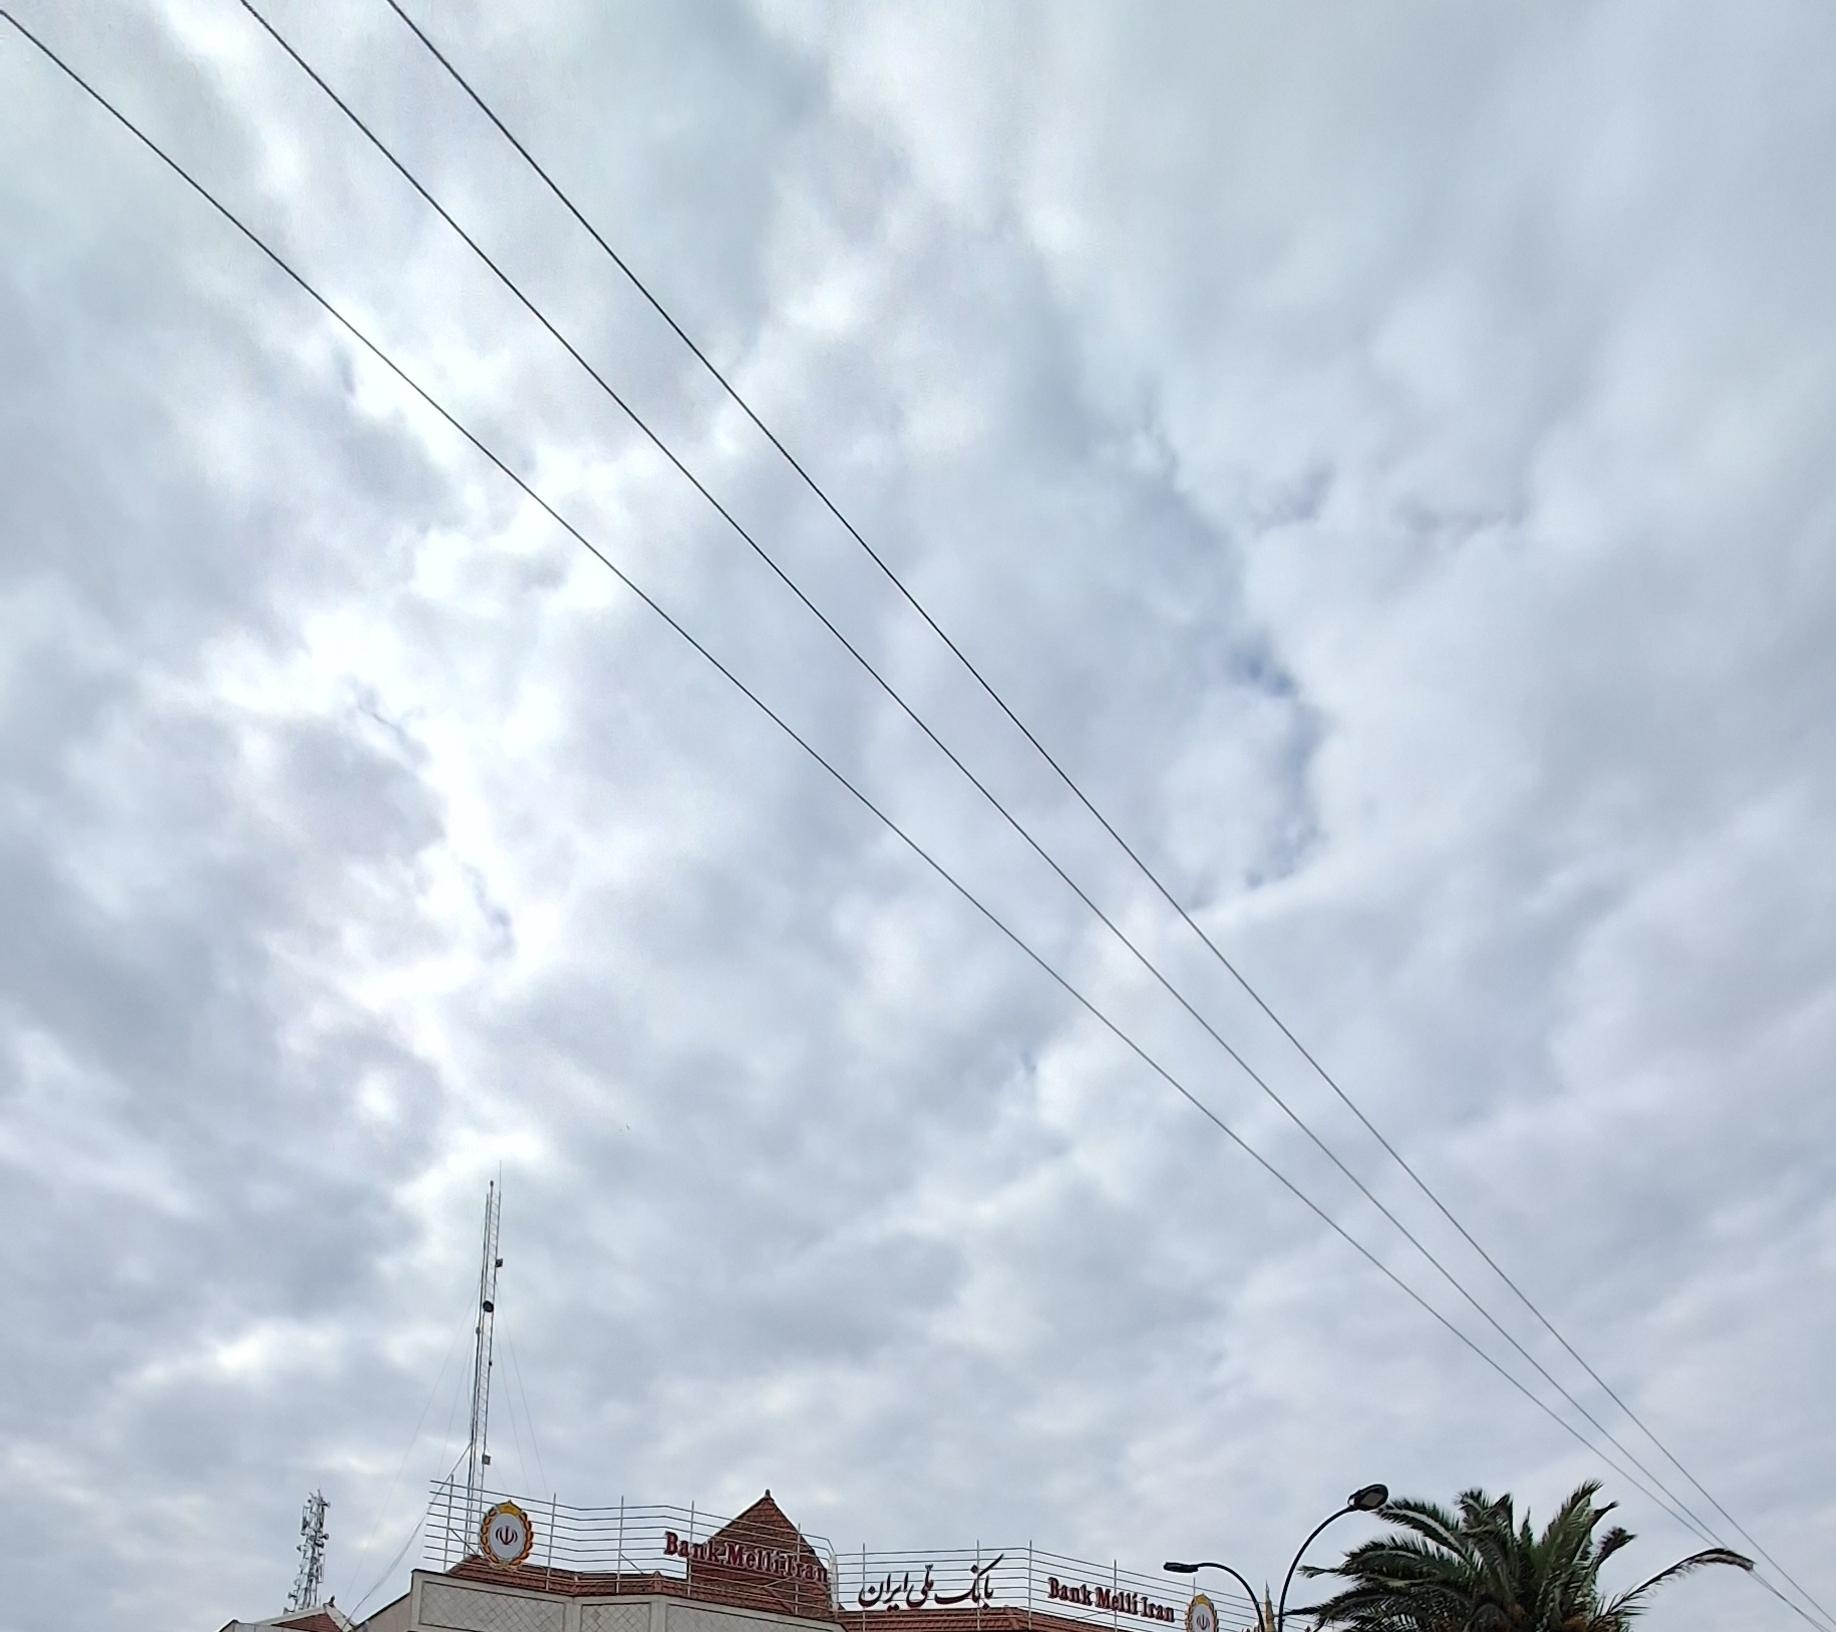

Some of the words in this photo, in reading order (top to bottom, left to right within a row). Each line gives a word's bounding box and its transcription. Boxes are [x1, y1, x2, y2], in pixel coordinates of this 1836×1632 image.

[664, 1531, 719, 1562] Bank
[725, 1541, 780, 1575] Melli
[781, 1554, 829, 1583] Iran
[934, 1553, 1004, 1610] بانک
[858, 1572, 909, 1612] ایران
[1048, 1577, 1092, 1606] Bank
[1095, 1586, 1138, 1615] Melli
[1140, 1596, 1175, 1623] Iran
